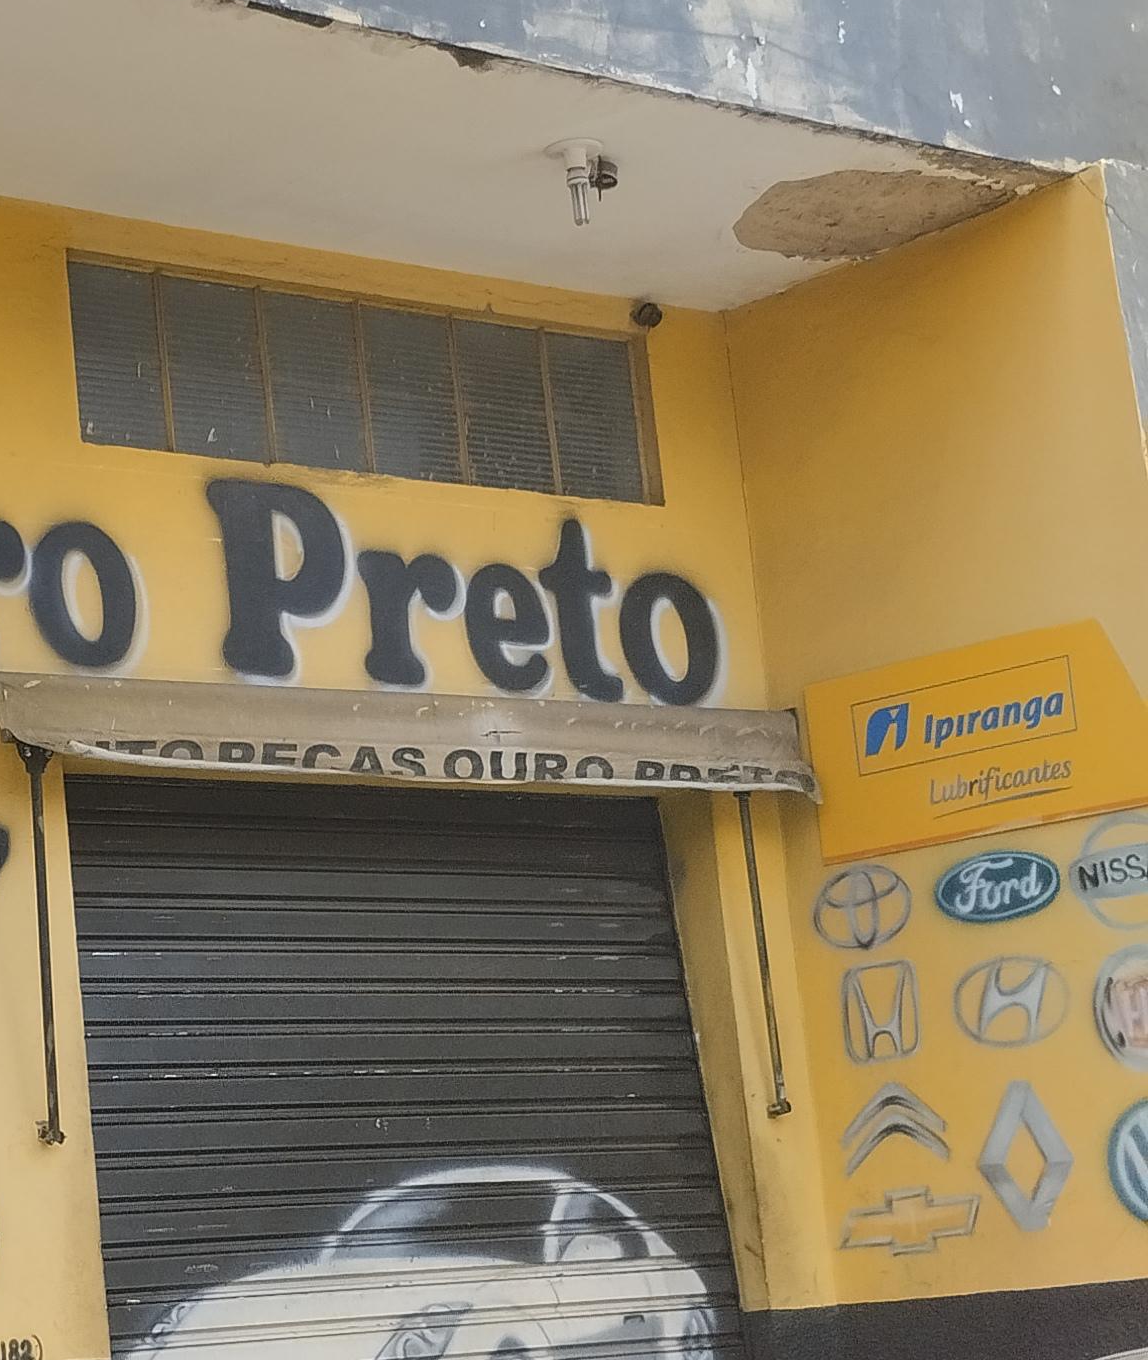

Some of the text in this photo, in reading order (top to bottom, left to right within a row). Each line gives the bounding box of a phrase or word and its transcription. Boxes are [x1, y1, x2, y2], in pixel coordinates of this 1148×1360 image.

[205, 476, 723, 708] Preto
[924, 691, 1064, 750] Ipiranga
[443, 748, 614, 782] OURO
[929, 759, 1072, 805] Lubrificantes
[954, 857, 1043, 914] Ford
[1078, 853, 1148, 892] NISS
